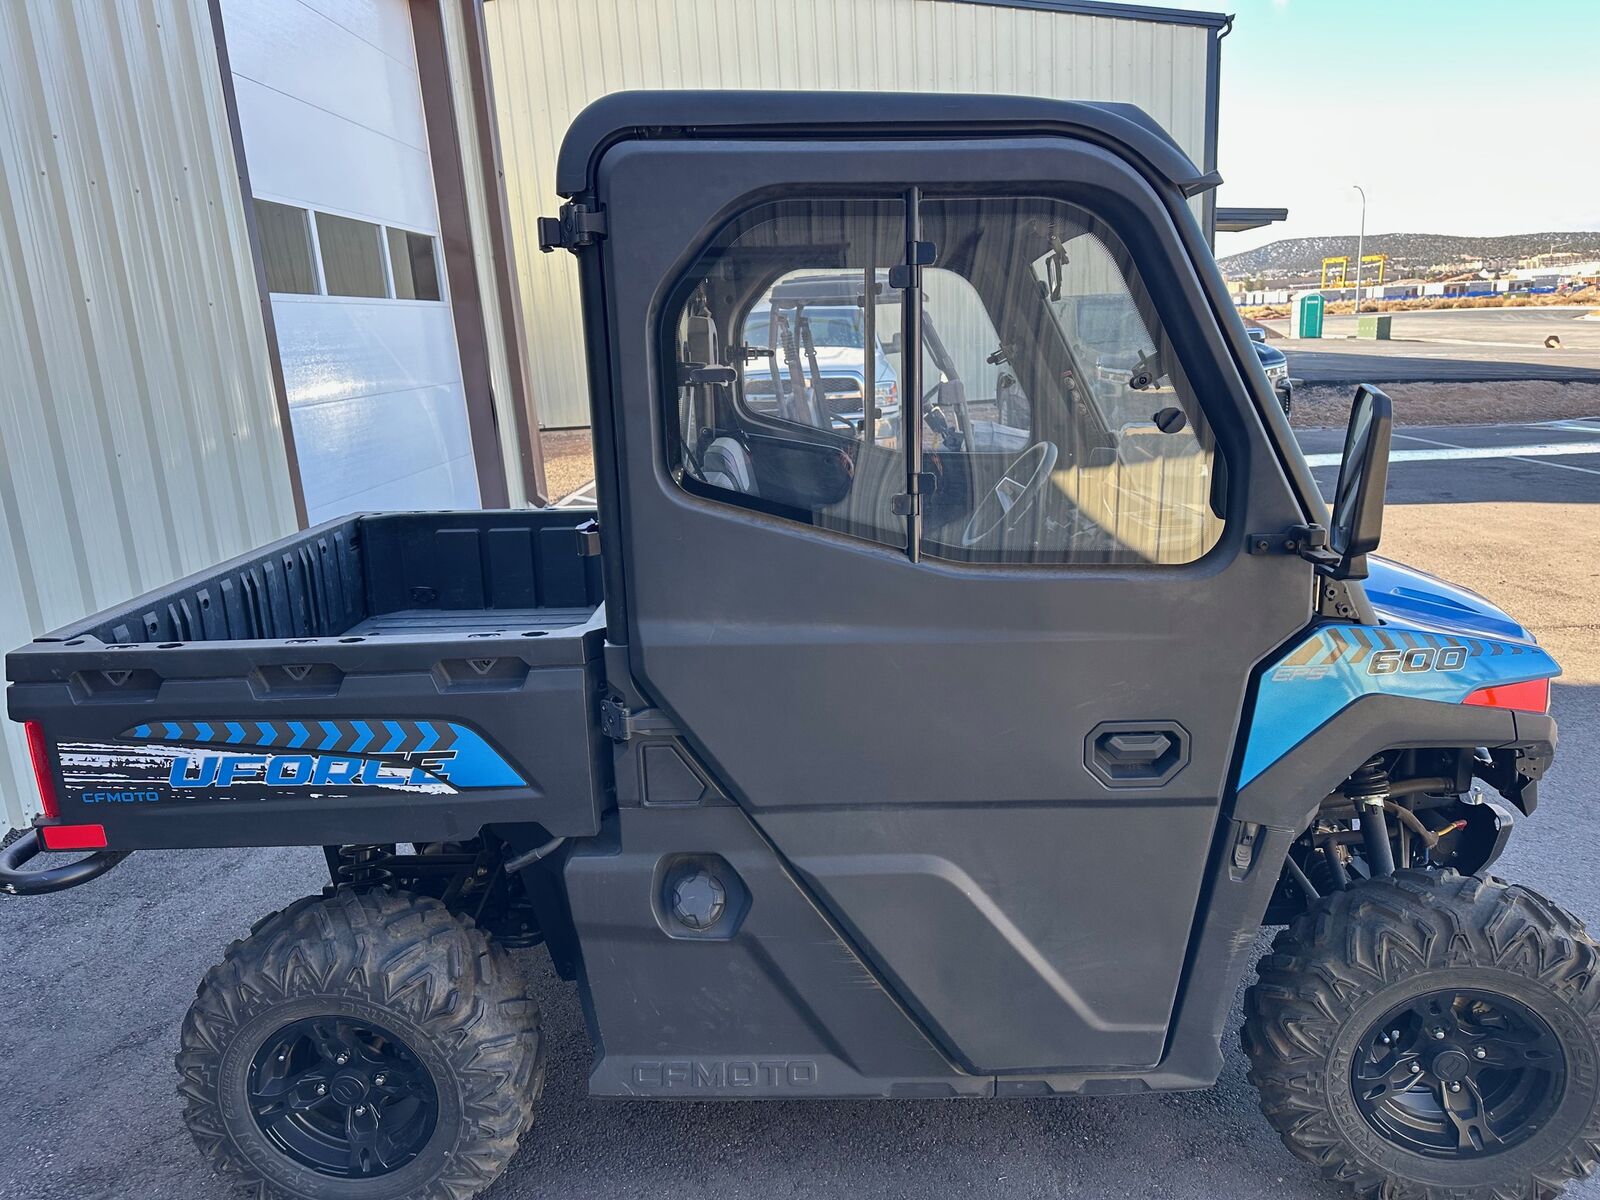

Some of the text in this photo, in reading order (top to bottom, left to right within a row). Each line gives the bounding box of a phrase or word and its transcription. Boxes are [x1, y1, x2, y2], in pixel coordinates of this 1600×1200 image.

[1272, 666, 1331, 681] EPS
[1367, 646, 1469, 676] 600
[168, 751, 458, 788] UFORCE
[82, 791, 160, 804] CFMOTO
[632, 1060, 818, 1088] CFMOTO
[1331, 1088, 1388, 1161] BRUISER
